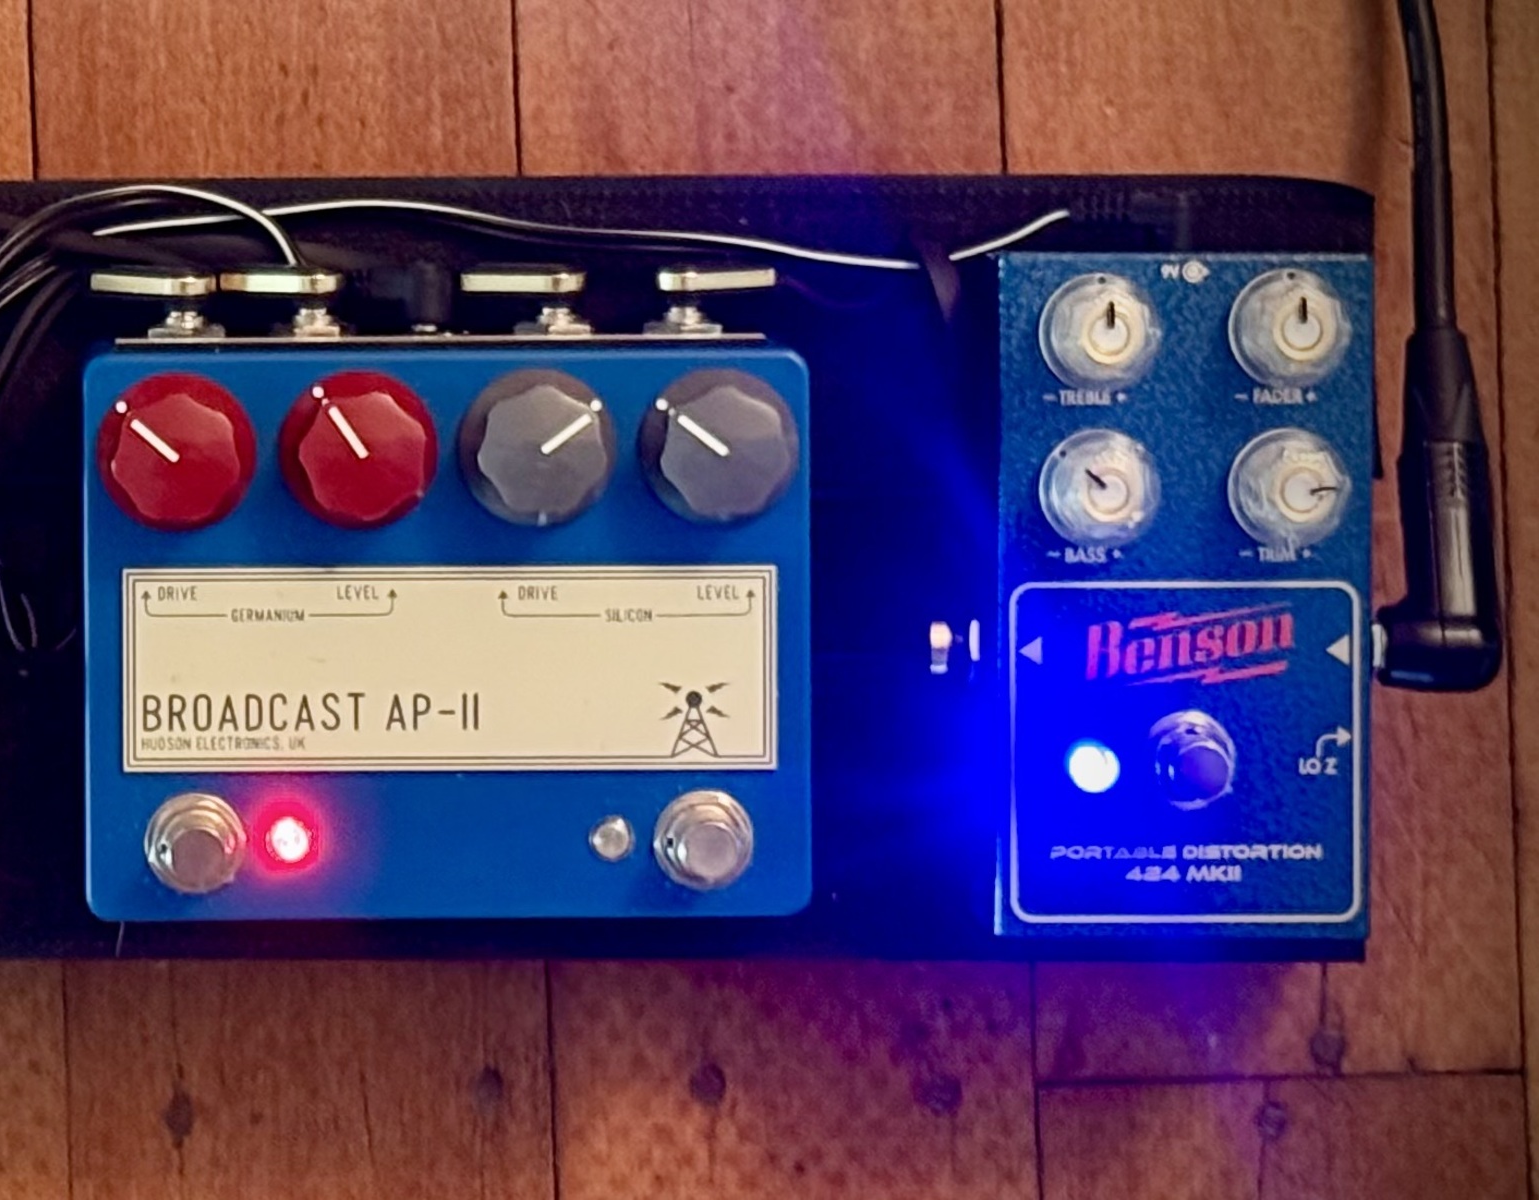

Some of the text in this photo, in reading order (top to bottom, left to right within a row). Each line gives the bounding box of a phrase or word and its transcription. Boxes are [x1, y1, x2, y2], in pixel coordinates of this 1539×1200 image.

[1059, 389, 1111, 405] TREBLE
[1253, 389, 1304, 405] FADER
[1064, 547, 1109, 564] BASS
[1259, 547, 1297, 562] TRIM
[157, 585, 380, 602] DRIVE LEVEL
[517, 584, 740, 602] DRIVE LEVEL
[231, 609, 305, 623] GERMANIUM
[605, 608, 653, 622] SILICON
[1086, 613, 1294, 681] Benson
[142, 691, 479, 732] BROADCAST AP-II
[141, 736, 192, 751] HUDSON
[289, 737, 306, 751] UK
[1050, 844, 1323, 860] PORTABLE DISTORTION
[1186, 864, 1243, 882] MKII
